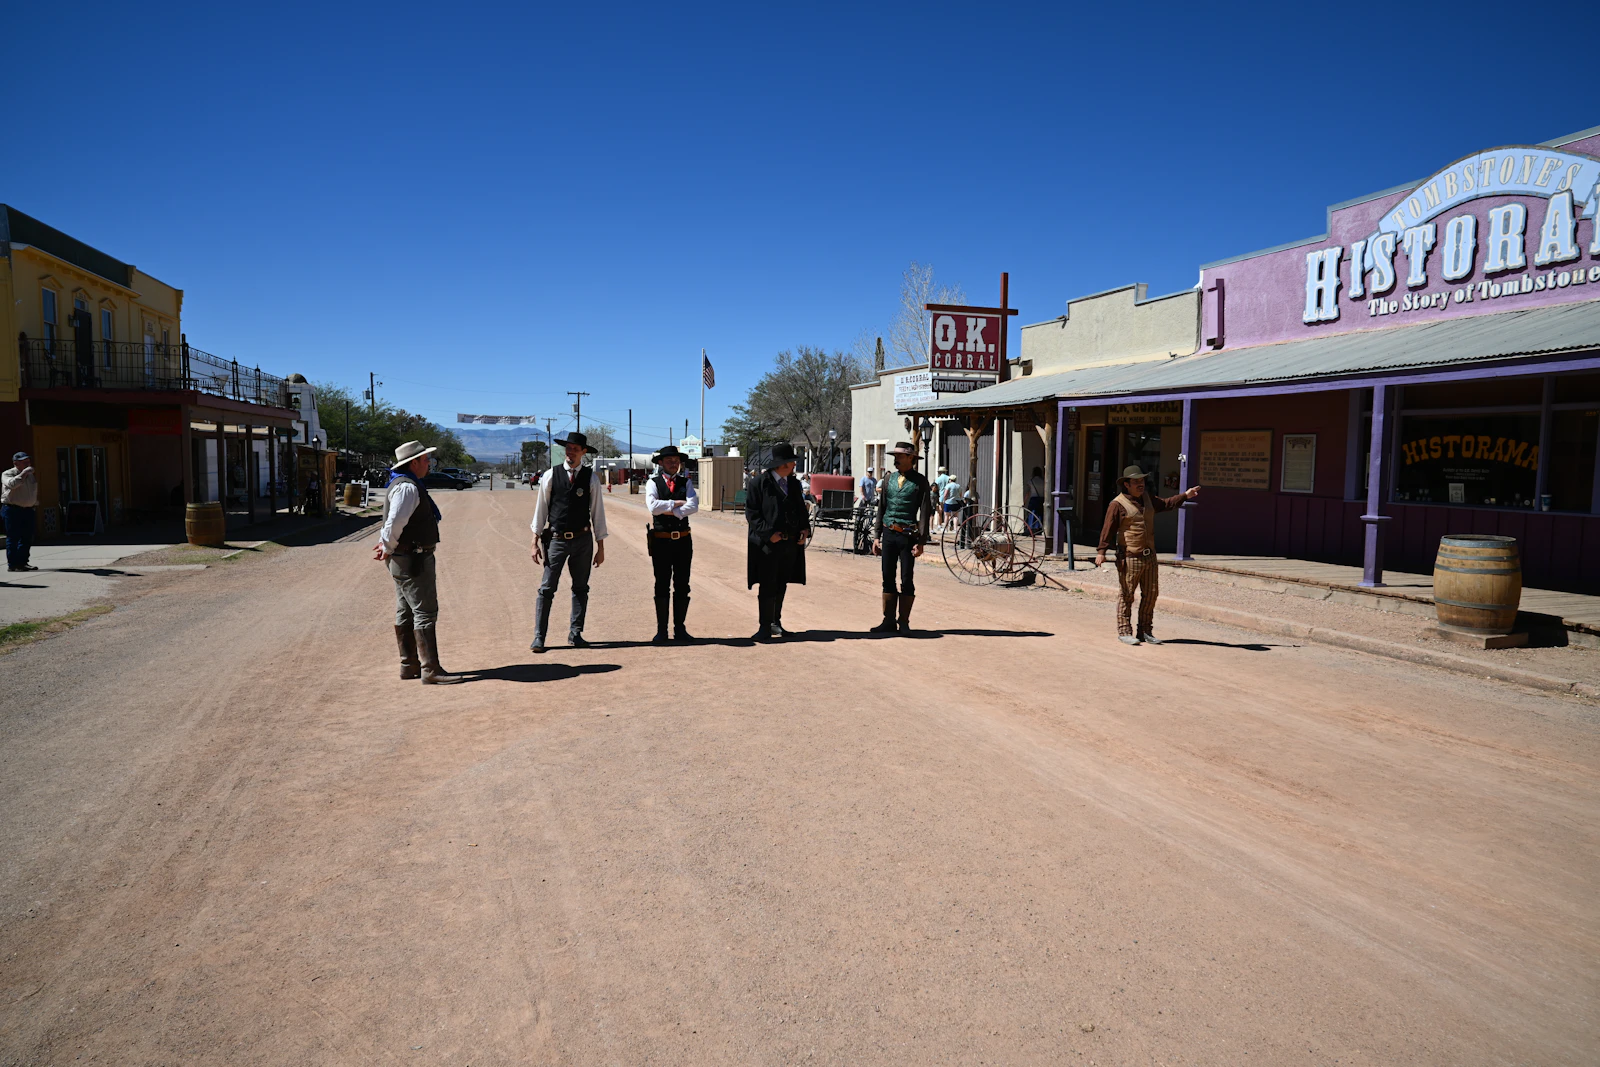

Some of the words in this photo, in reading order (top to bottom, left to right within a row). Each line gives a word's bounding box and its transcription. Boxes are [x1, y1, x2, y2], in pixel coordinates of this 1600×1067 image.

[1391, 155, 1582, 231] TOMBSTONE'S
[1303, 183, 1600, 323] HISTORA
[1368, 298, 1399, 317] The
[1402, 292, 1451, 311] Story
[1454, 284, 1475, 303] of
[1477, 265, 1600, 300] Tombstone
[934, 315, 995, 353] O.K.
[934, 352, 996, 369] CORRAL
[933, 380, 975, 392] GUNFIGHT
[1402, 435, 1539, 471] HISTORAMA
